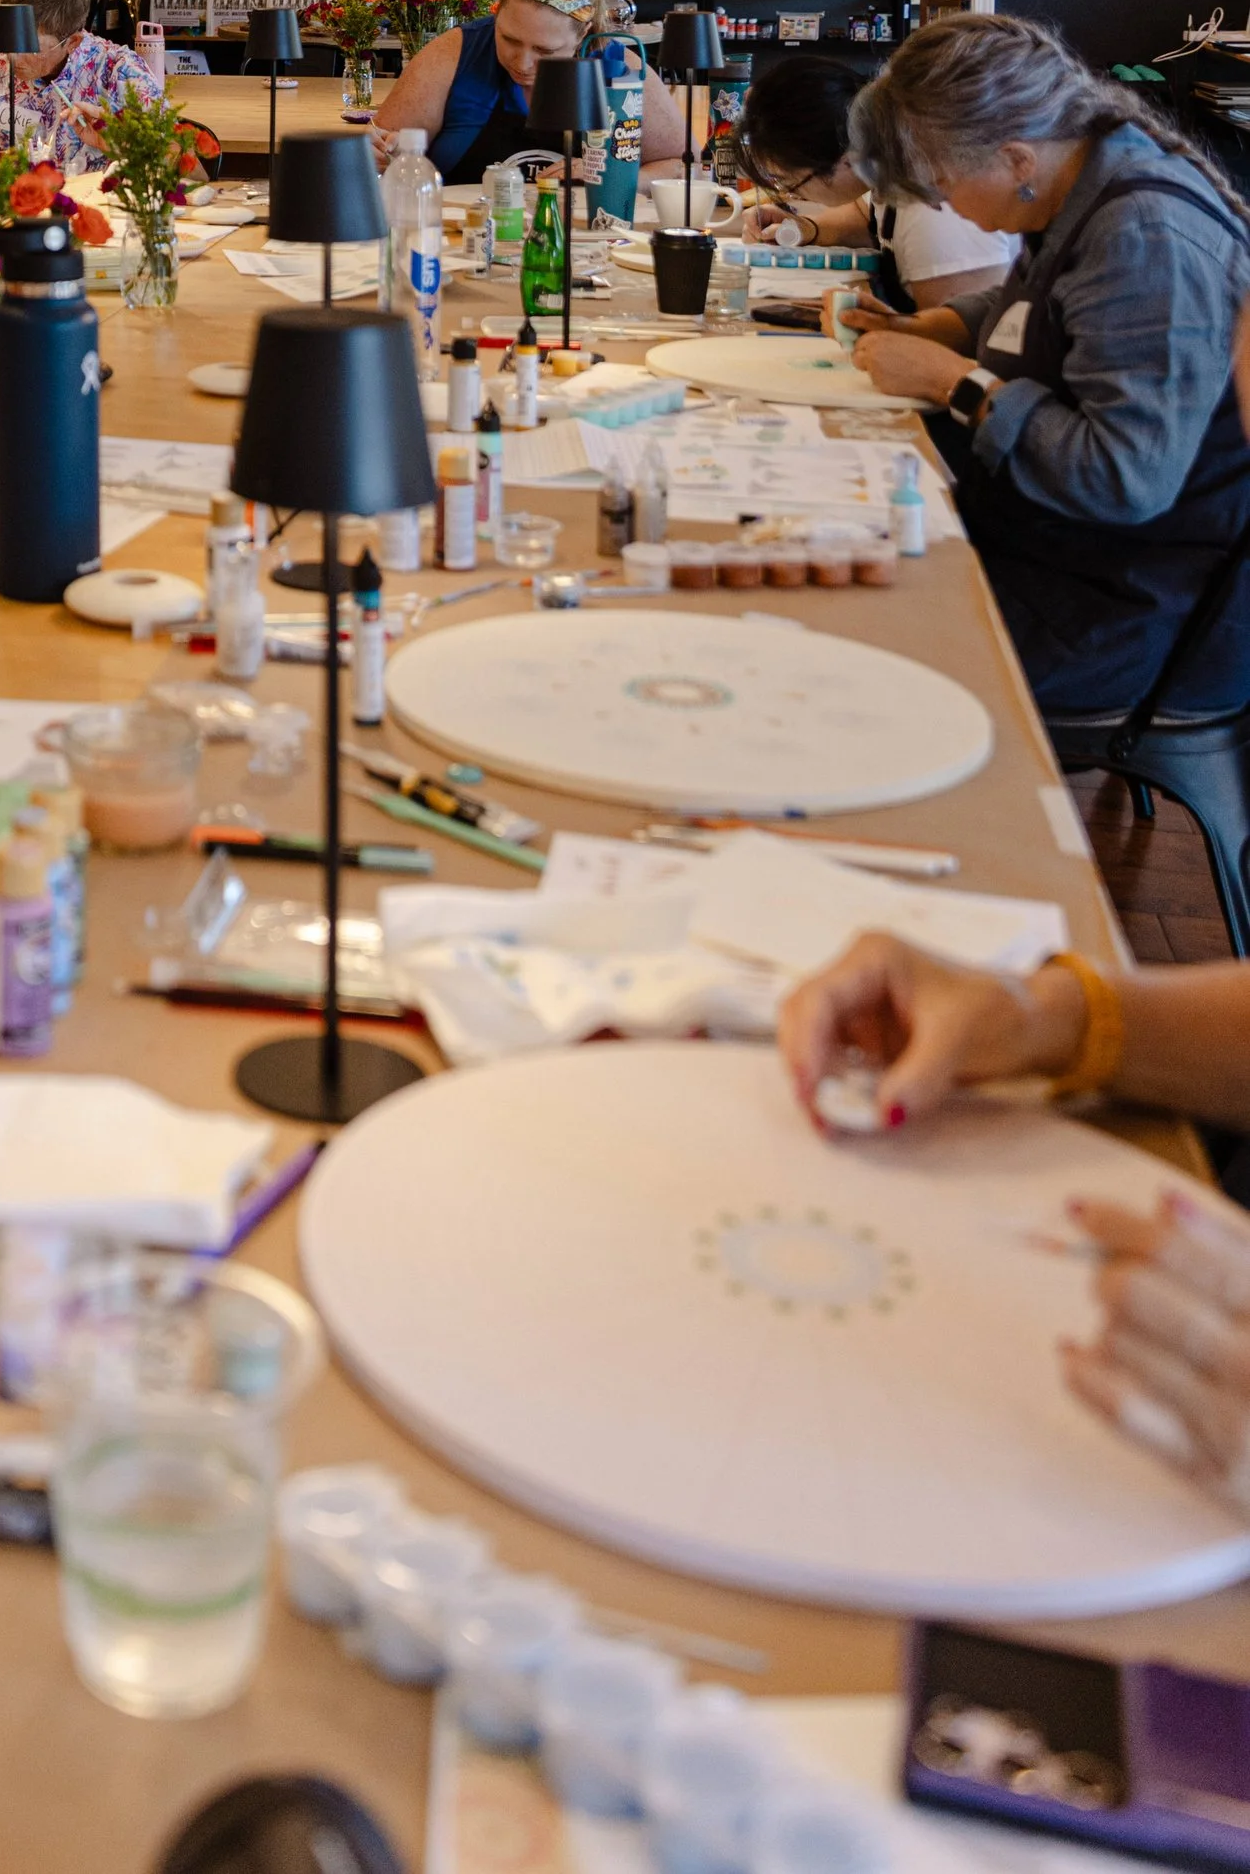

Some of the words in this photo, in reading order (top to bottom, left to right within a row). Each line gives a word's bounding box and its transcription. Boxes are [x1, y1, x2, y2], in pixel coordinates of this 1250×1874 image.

[178, 56, 191, 64] THE
[177, 64, 199, 72] EARTH
[527, 164, 547, 177] TH
